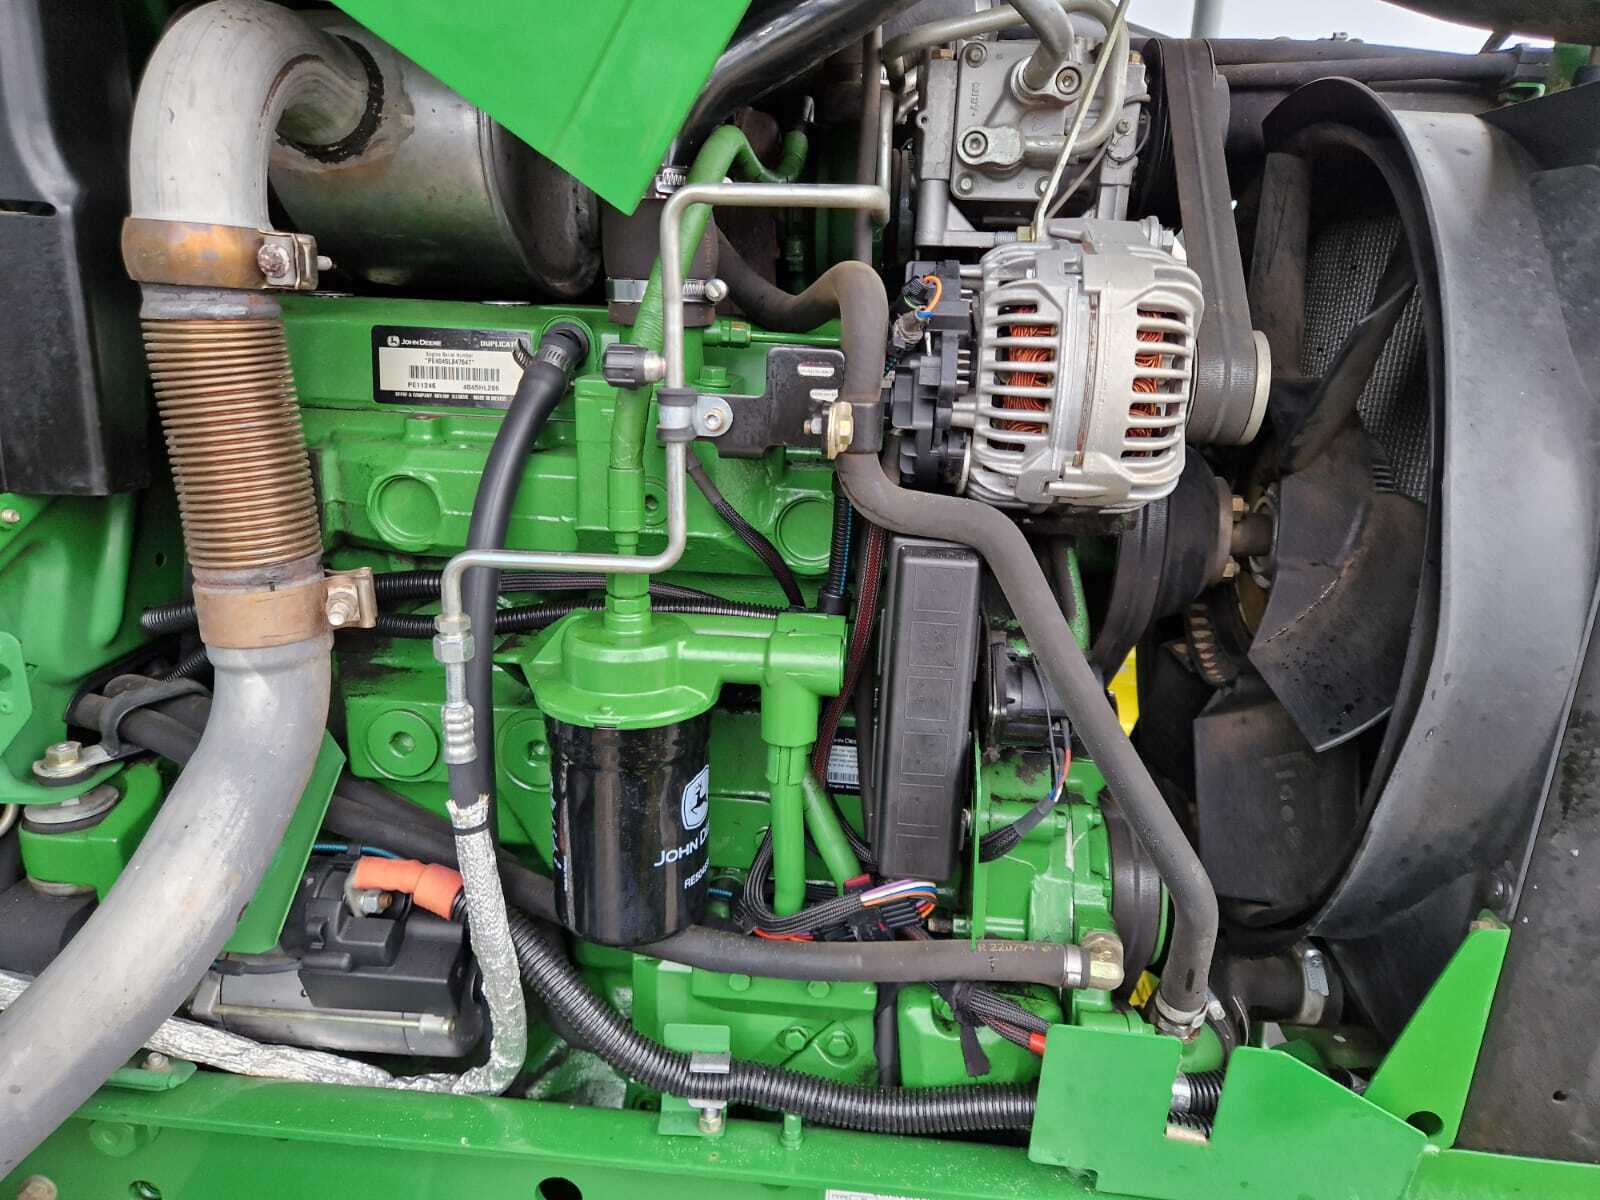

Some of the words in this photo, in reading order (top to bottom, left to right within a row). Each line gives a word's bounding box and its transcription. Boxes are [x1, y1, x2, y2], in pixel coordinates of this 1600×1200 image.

[401, 338, 419, 346] JOHN
[480, 340, 515, 348] DUPLICAT
[653, 837, 698, 867] JOHN
